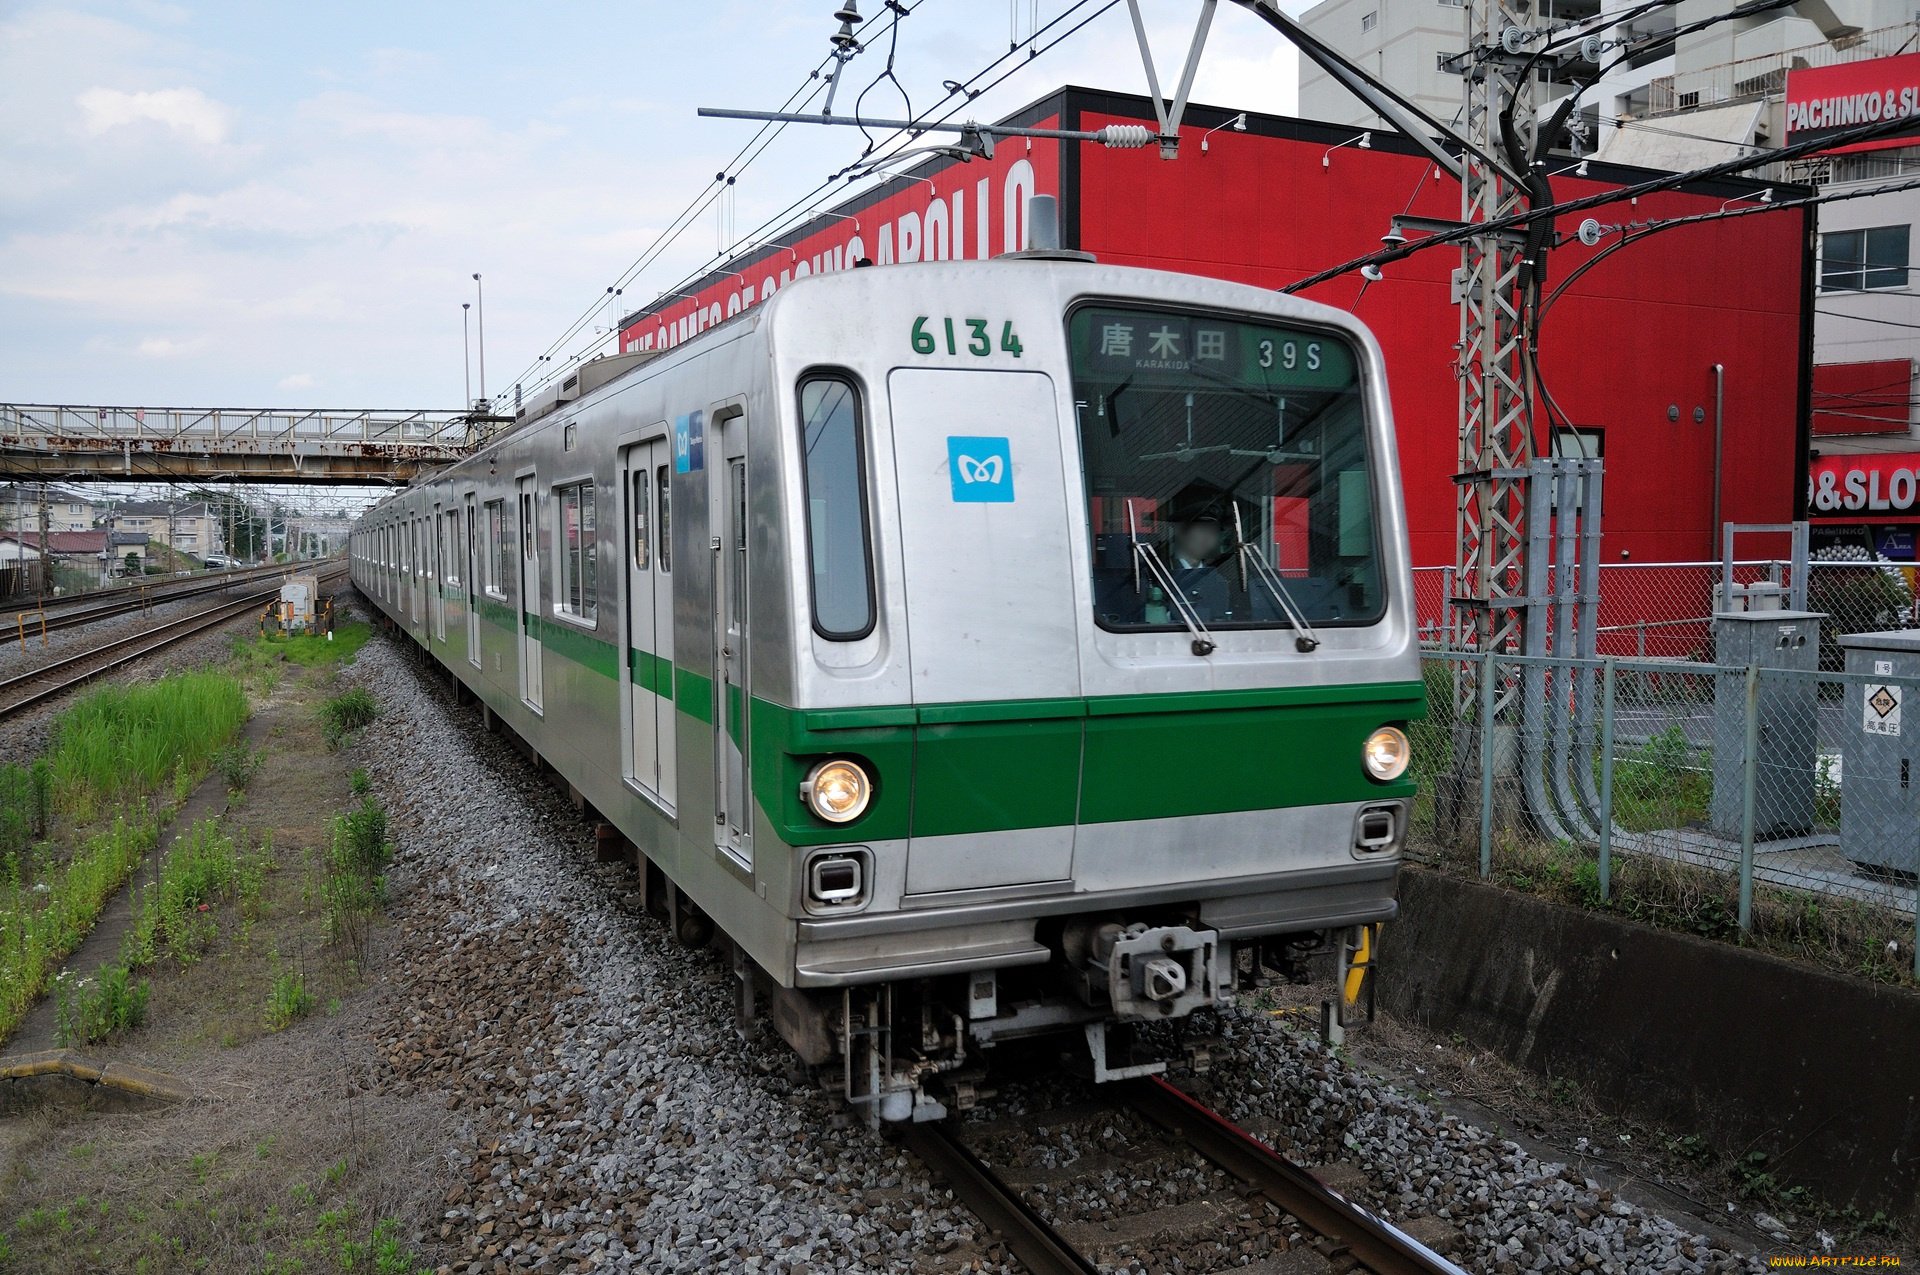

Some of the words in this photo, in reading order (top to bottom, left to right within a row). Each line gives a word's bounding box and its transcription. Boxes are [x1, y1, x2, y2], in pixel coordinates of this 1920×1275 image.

[1787, 92, 1881, 131] PACHINKO
[911, 316, 1023, 357] 6134
[1100, 323, 1225, 361] 唐木田
[1135, 359, 1190, 371] KARAKIDA
[1844, 468, 1920, 511] SLO
[1875, 697, 1890, 707] 危険
[1866, 720, 1898, 733] 高電圧
